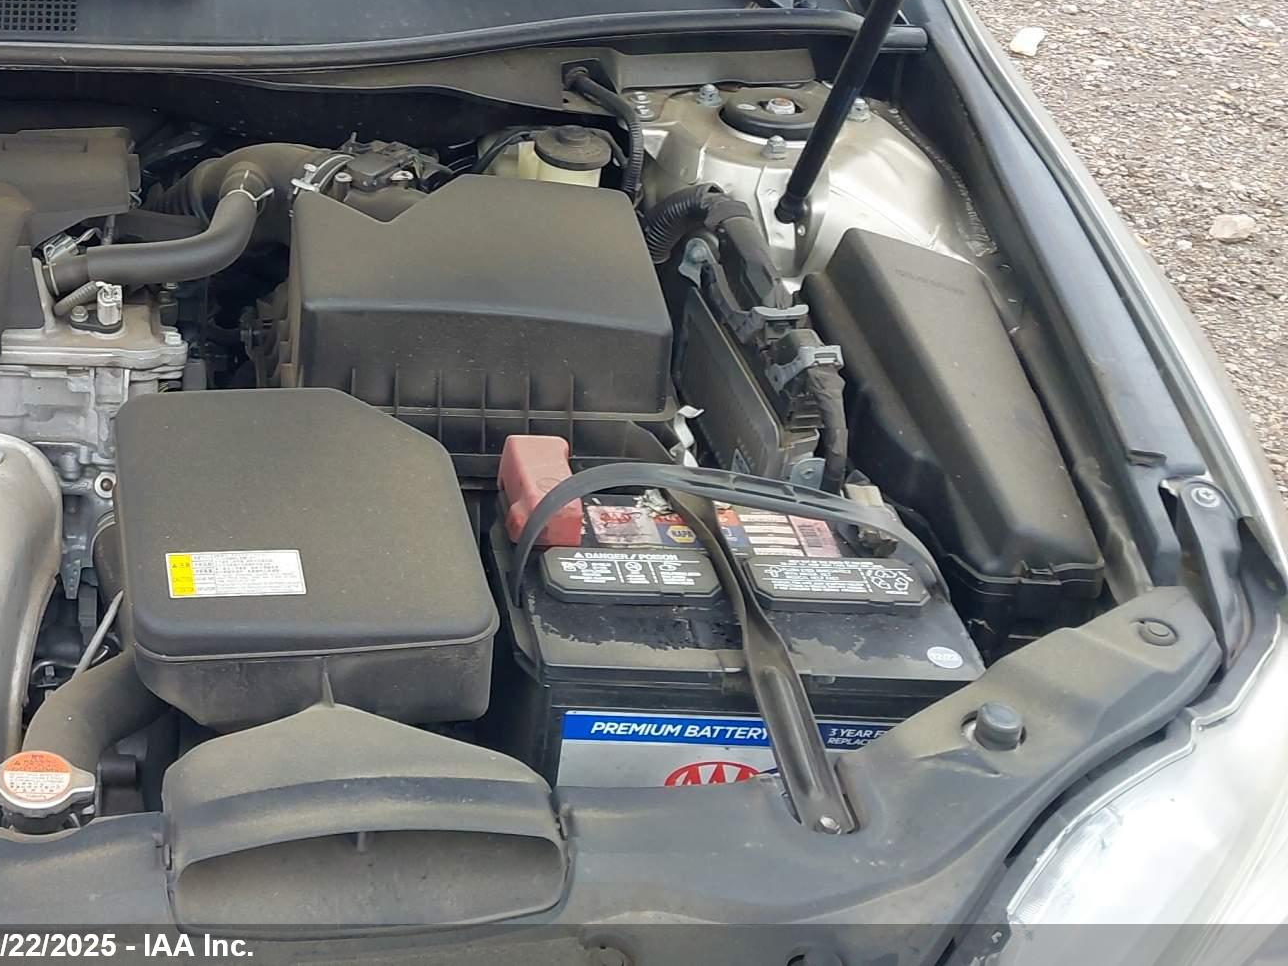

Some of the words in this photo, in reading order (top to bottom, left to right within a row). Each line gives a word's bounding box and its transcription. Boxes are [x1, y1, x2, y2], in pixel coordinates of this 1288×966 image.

[584, 552, 628, 560] DANGER
[638, 553, 679, 561] POISON
[590, 721, 682, 737] PREMIUM
[684, 724, 769, 740] BATTERY
[828, 728, 838, 737] 3
[839, 728, 873, 738] YEAR
